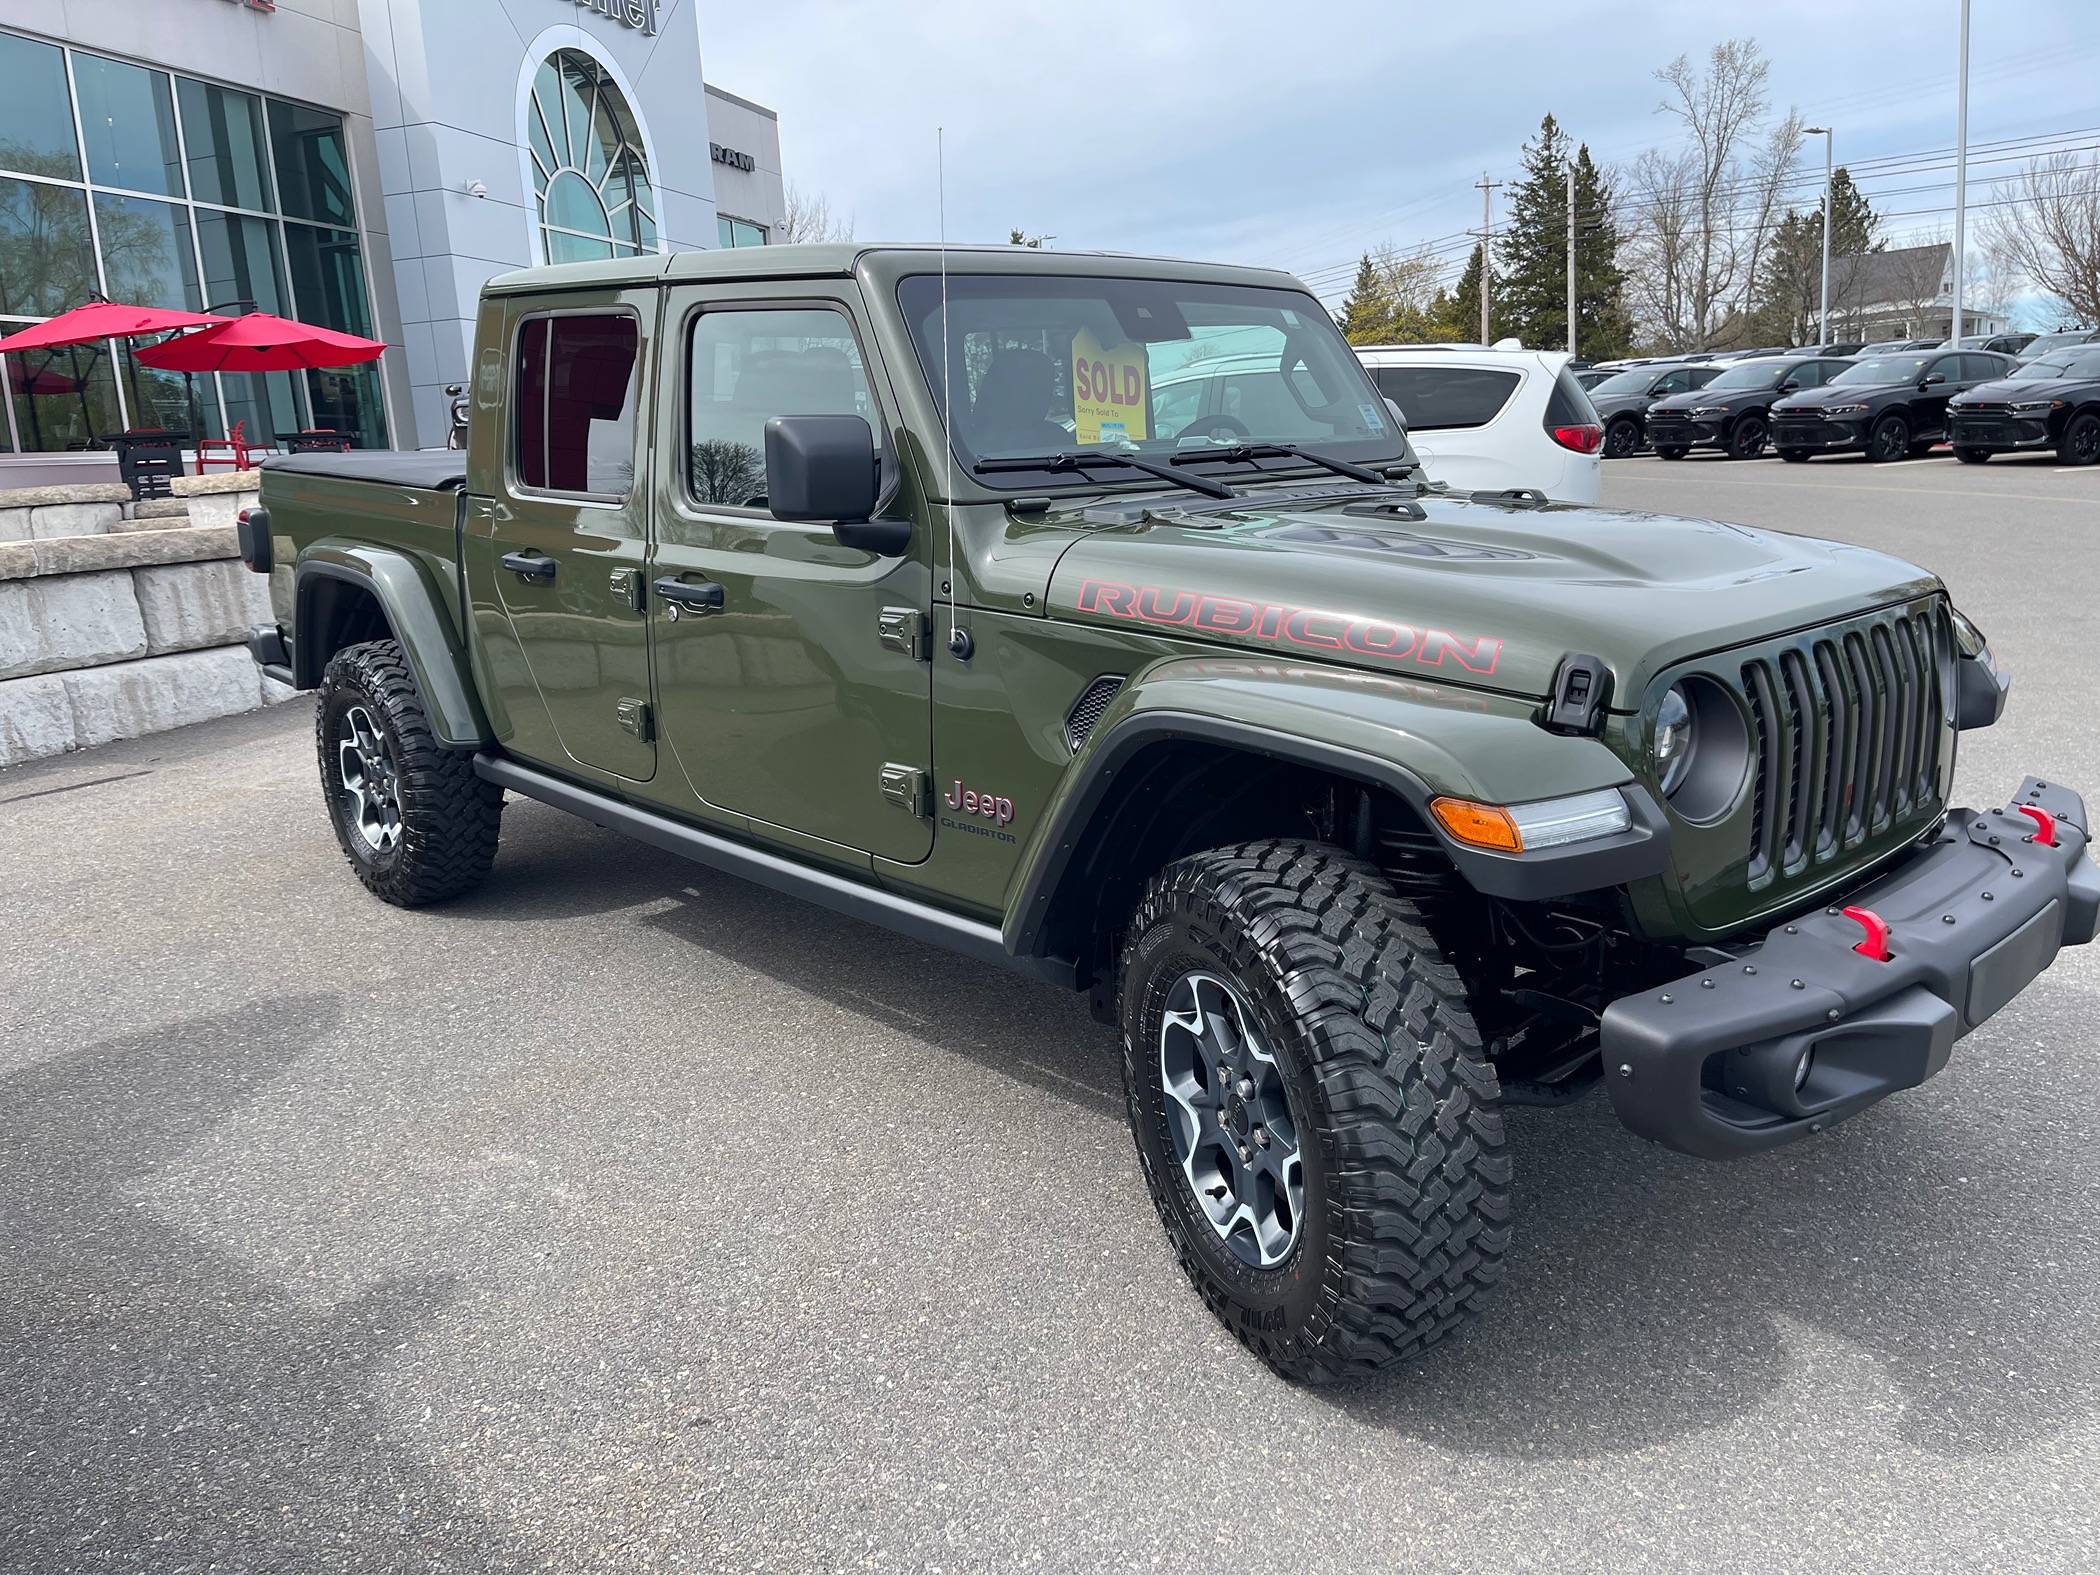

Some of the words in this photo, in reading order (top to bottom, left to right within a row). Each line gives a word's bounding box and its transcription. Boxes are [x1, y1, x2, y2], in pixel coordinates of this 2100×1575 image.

[709, 142, 755, 172] RAM
[1076, 357, 1141, 406] SOLD
[1077, 405, 1095, 416] Sorry
[1096, 408, 1110, 417] Sold
[1111, 410, 1119, 418] To
[1077, 579, 1504, 675] RUBICON
[944, 780, 1014, 828] Jeep
[941, 818, 1017, 845] GLADIATOR
